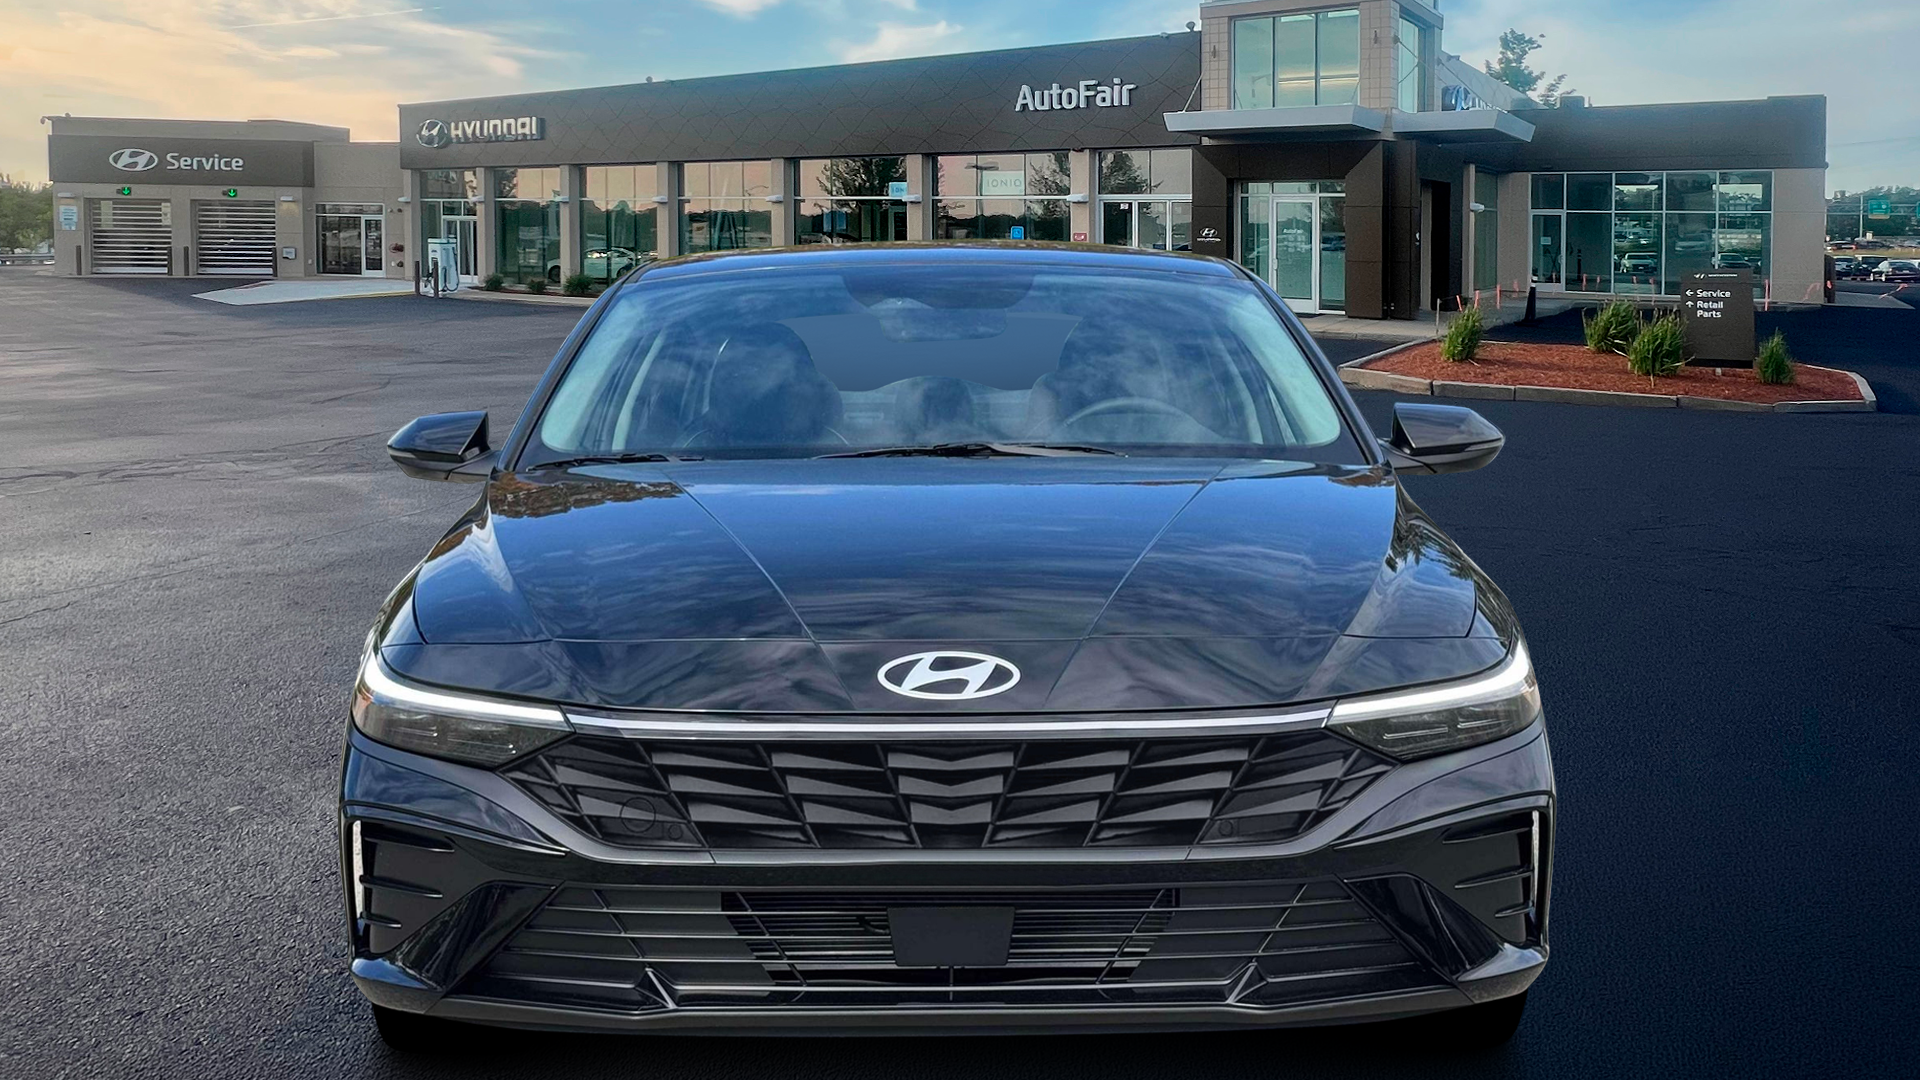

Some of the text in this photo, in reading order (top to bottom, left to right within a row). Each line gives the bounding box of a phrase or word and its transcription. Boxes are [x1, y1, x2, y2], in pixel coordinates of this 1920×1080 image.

[1014, 77, 1137, 112] AutoFair
[450, 116, 538, 142] HYUNDAI
[165, 152, 244, 171] Service
[1696, 289, 1732, 298] Service
[1696, 301, 1724, 309] Retail
[1696, 310, 1722, 318] Parts
